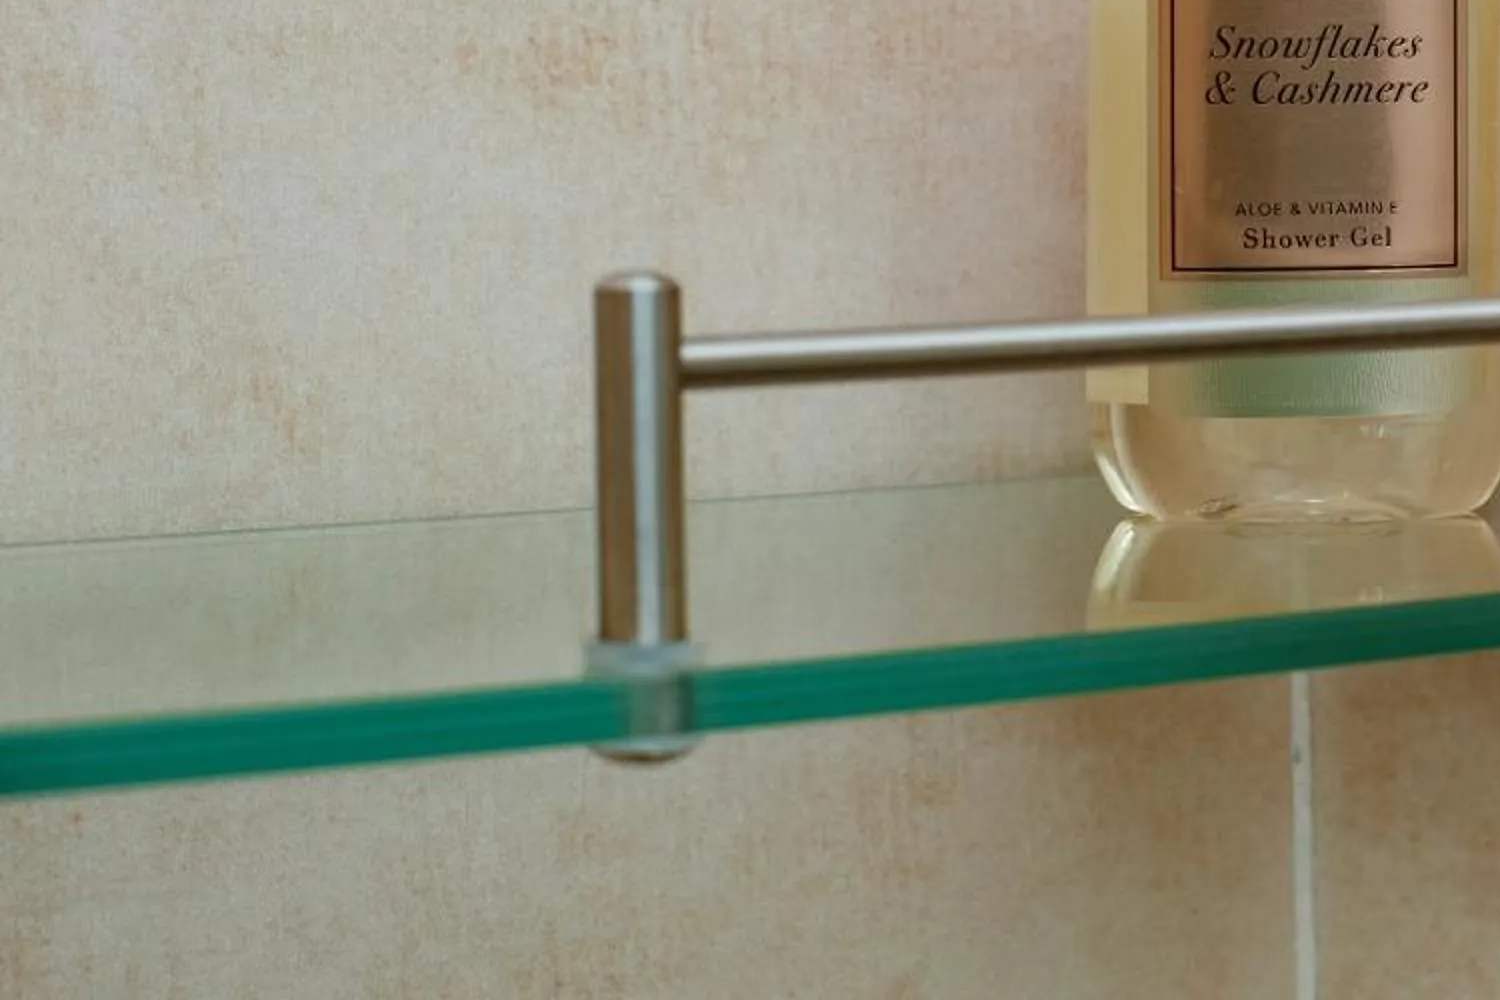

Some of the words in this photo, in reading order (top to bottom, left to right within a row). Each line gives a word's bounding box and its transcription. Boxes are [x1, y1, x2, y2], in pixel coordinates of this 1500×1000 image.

[1208, 23, 1424, 70] Snowflakes
[1205, 70, 1236, 106] &
[1252, 70, 1430, 106] Cashmere
[1234, 202, 1283, 217] ALOE
[1289, 202, 1301, 216] &
[1308, 201, 1384, 216] VITAMIN
[1389, 201, 1400, 215] E
[1242, 227, 1340, 249] Shower
[1351, 225, 1392, 248] Gel
